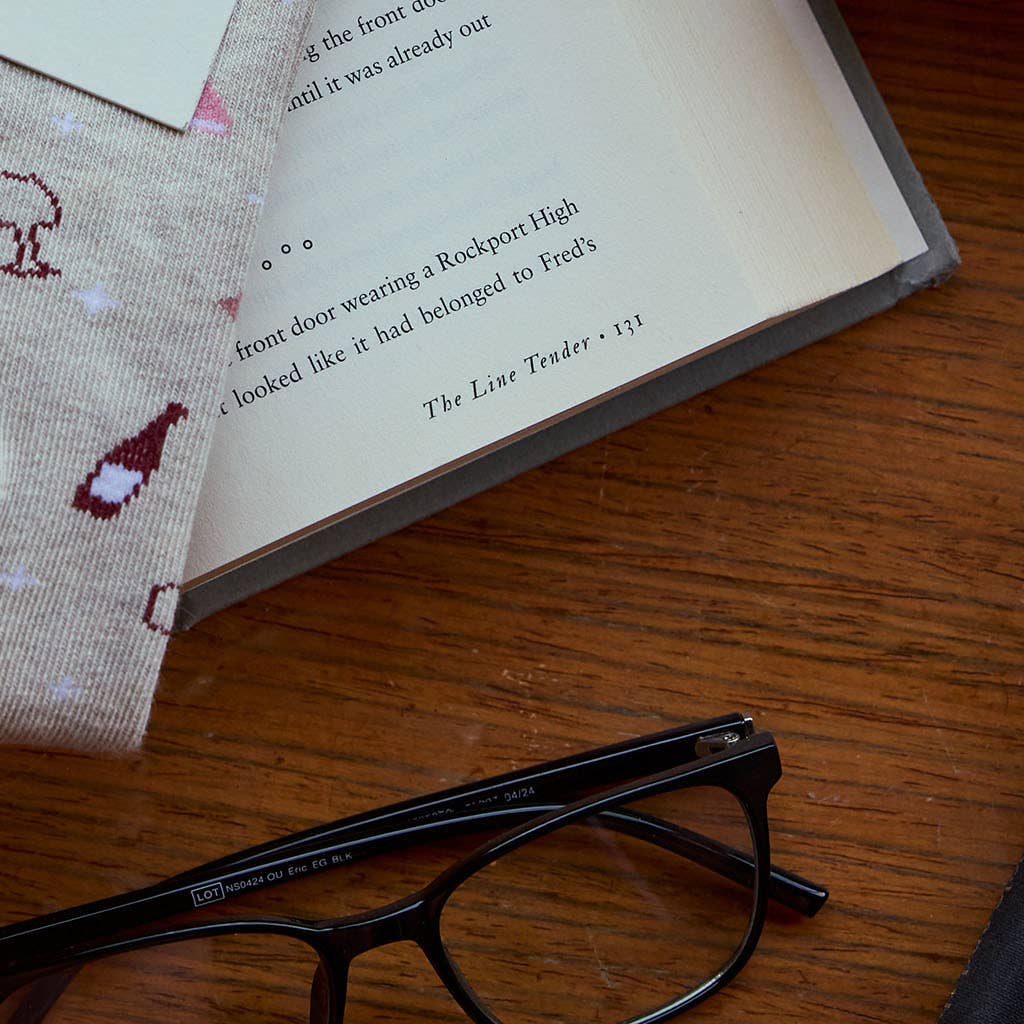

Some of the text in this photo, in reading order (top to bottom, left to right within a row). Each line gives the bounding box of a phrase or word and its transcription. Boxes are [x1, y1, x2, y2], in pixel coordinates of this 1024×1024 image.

[285, 15, 492, 112] ntil it was already out
[322, 30, 353, 50] the
[358, 6, 407, 36] front
[236, 198, 579, 361] front door wearing a Rockport High
[232, 362, 303, 408] looked
[307, 350, 346, 374] like
[352, 337, 369, 354] it
[373, 313, 414, 344] had
[418, 272, 506, 324] belonged
[513, 268, 533, 284] to
[423, 314, 643, 419] The Line Tender 131
[196, 887, 220, 902] LOT
[312, 858, 327, 869] EG
[331, 851, 353, 864] BLK
